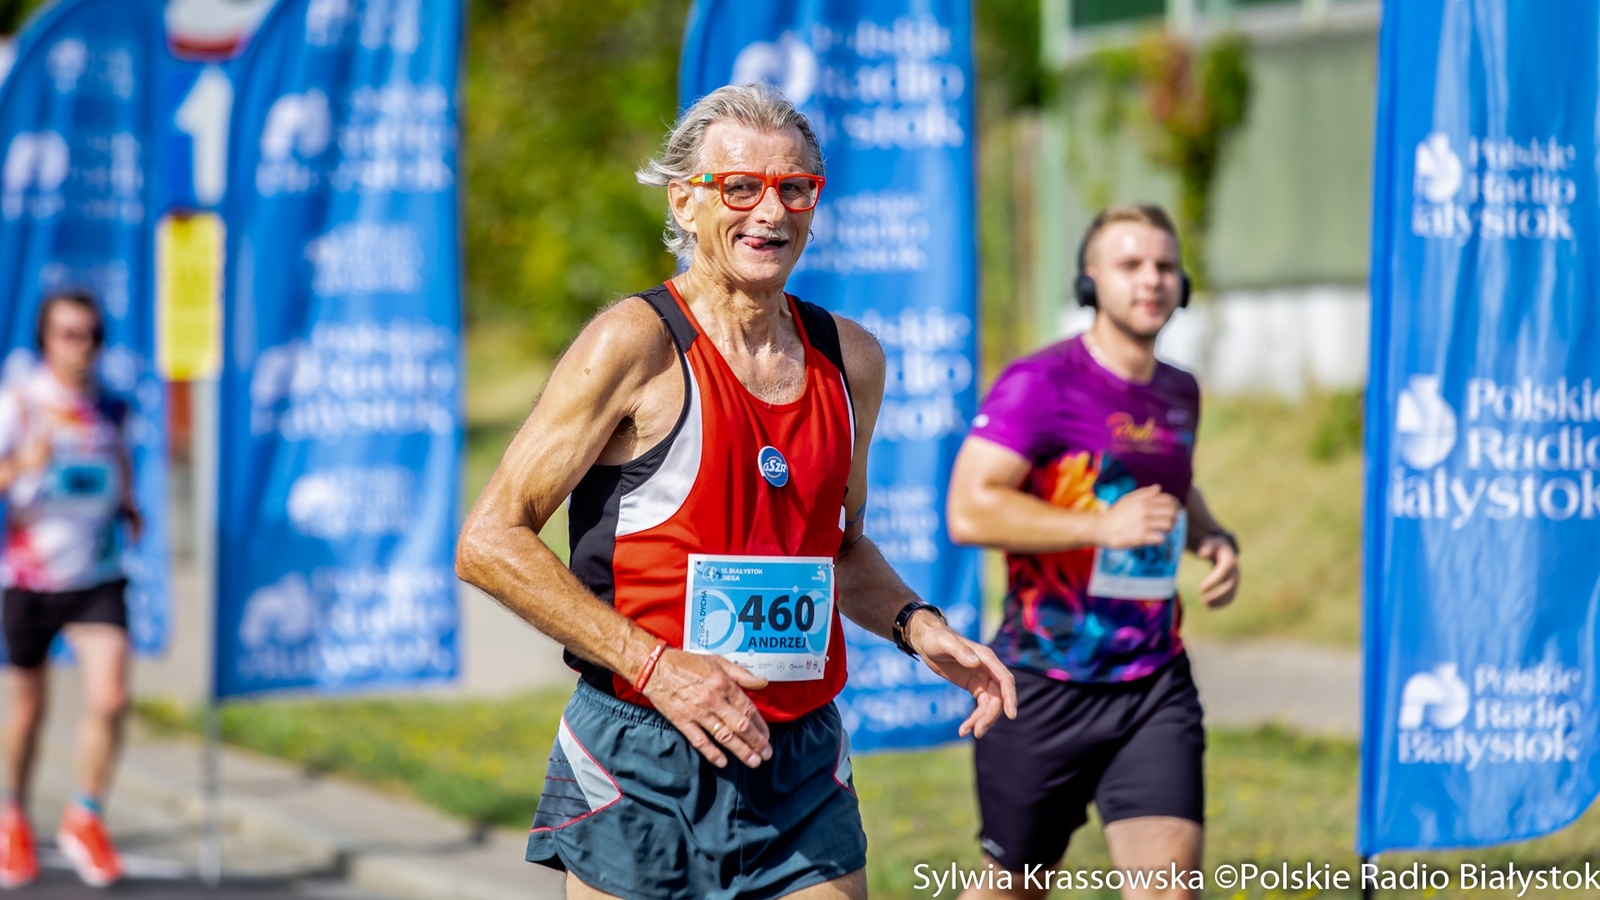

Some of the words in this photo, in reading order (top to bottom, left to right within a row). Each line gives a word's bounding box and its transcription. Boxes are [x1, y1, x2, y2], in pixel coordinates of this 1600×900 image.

[1468, 375, 1600, 422] Polski
[737, 595, 815, 632] 460
[748, 636, 807, 649] ANDRZEJ
